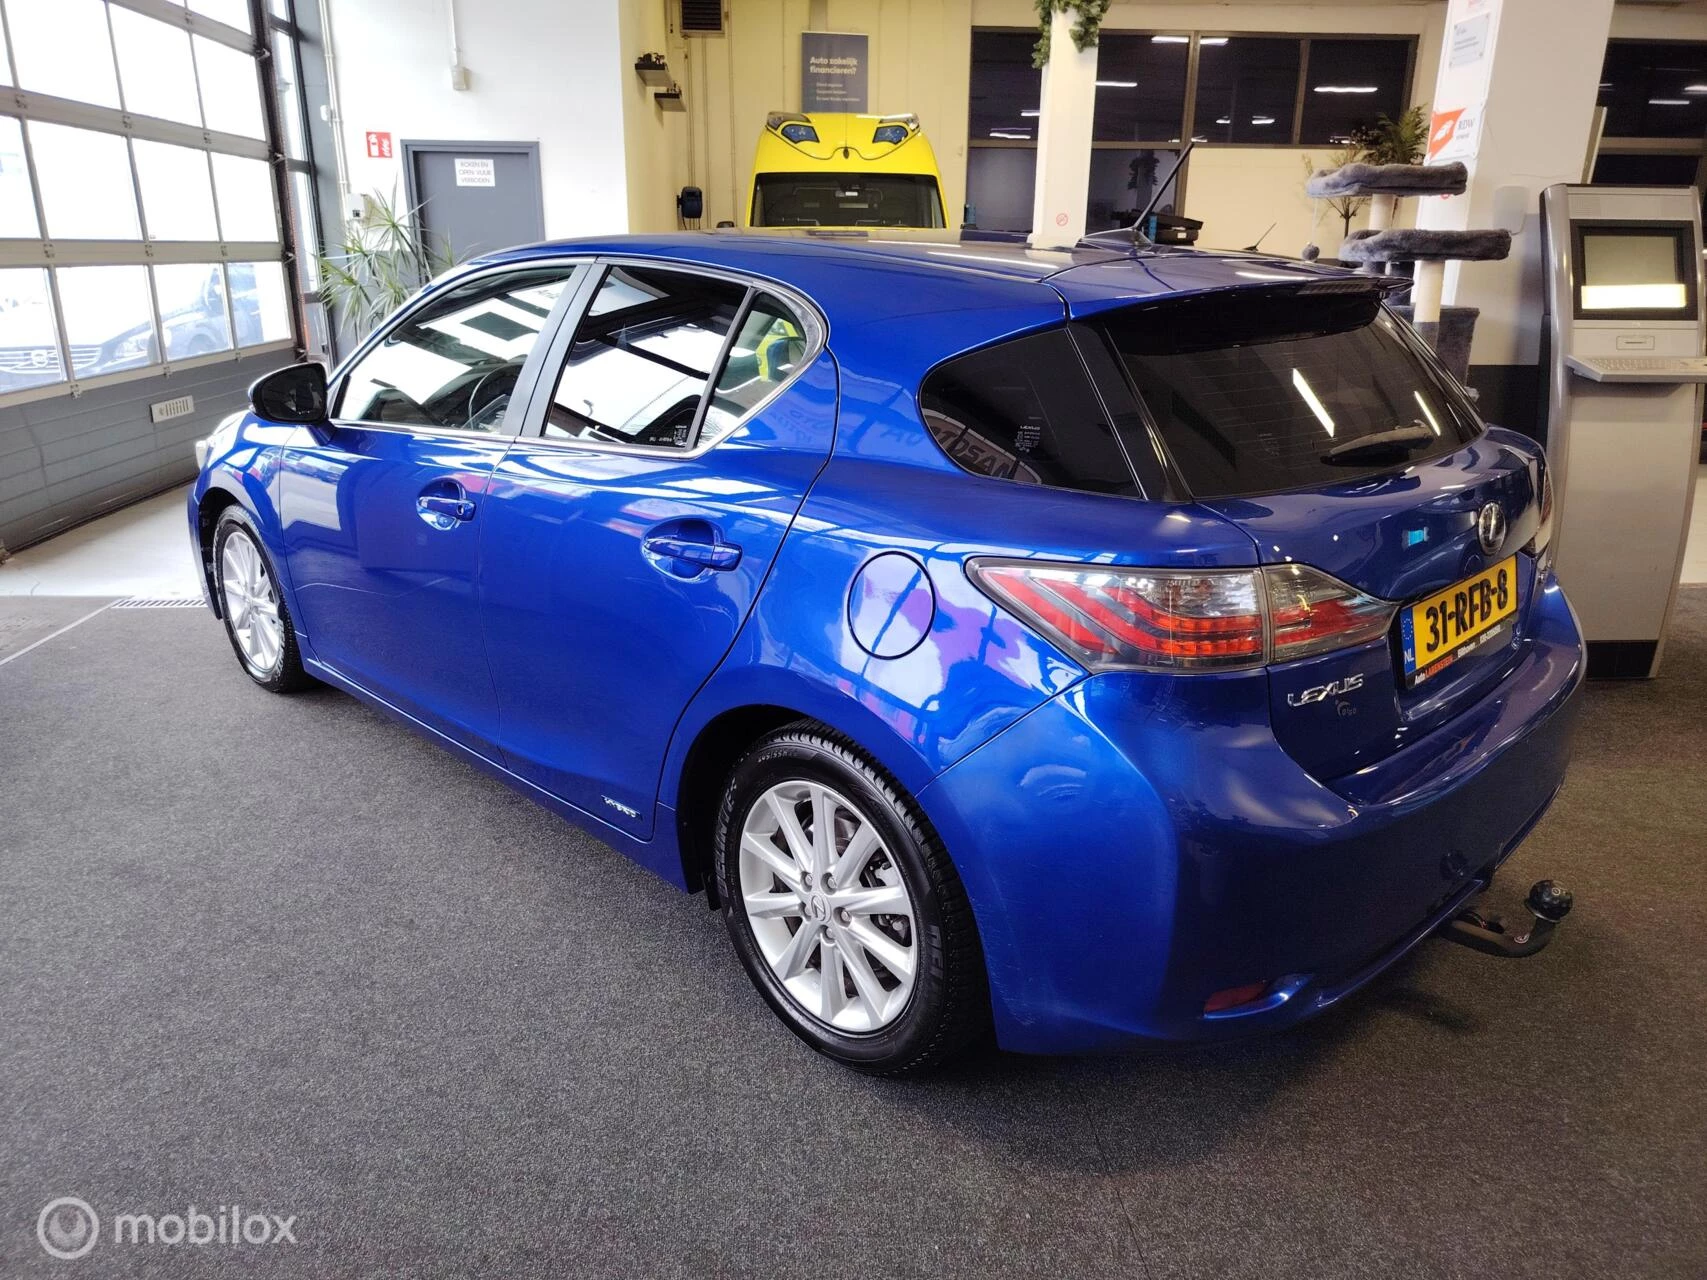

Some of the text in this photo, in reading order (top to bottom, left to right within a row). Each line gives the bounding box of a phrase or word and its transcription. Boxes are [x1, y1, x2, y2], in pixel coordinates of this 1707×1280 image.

[809, 56, 828, 65] Auto
[809, 66, 857, 75] financieren?
[1426, 568, 1508, 653] 31-RFB-8
[1404, 647, 1415, 665] NL
[1287, 673, 1364, 707] LEXUS
